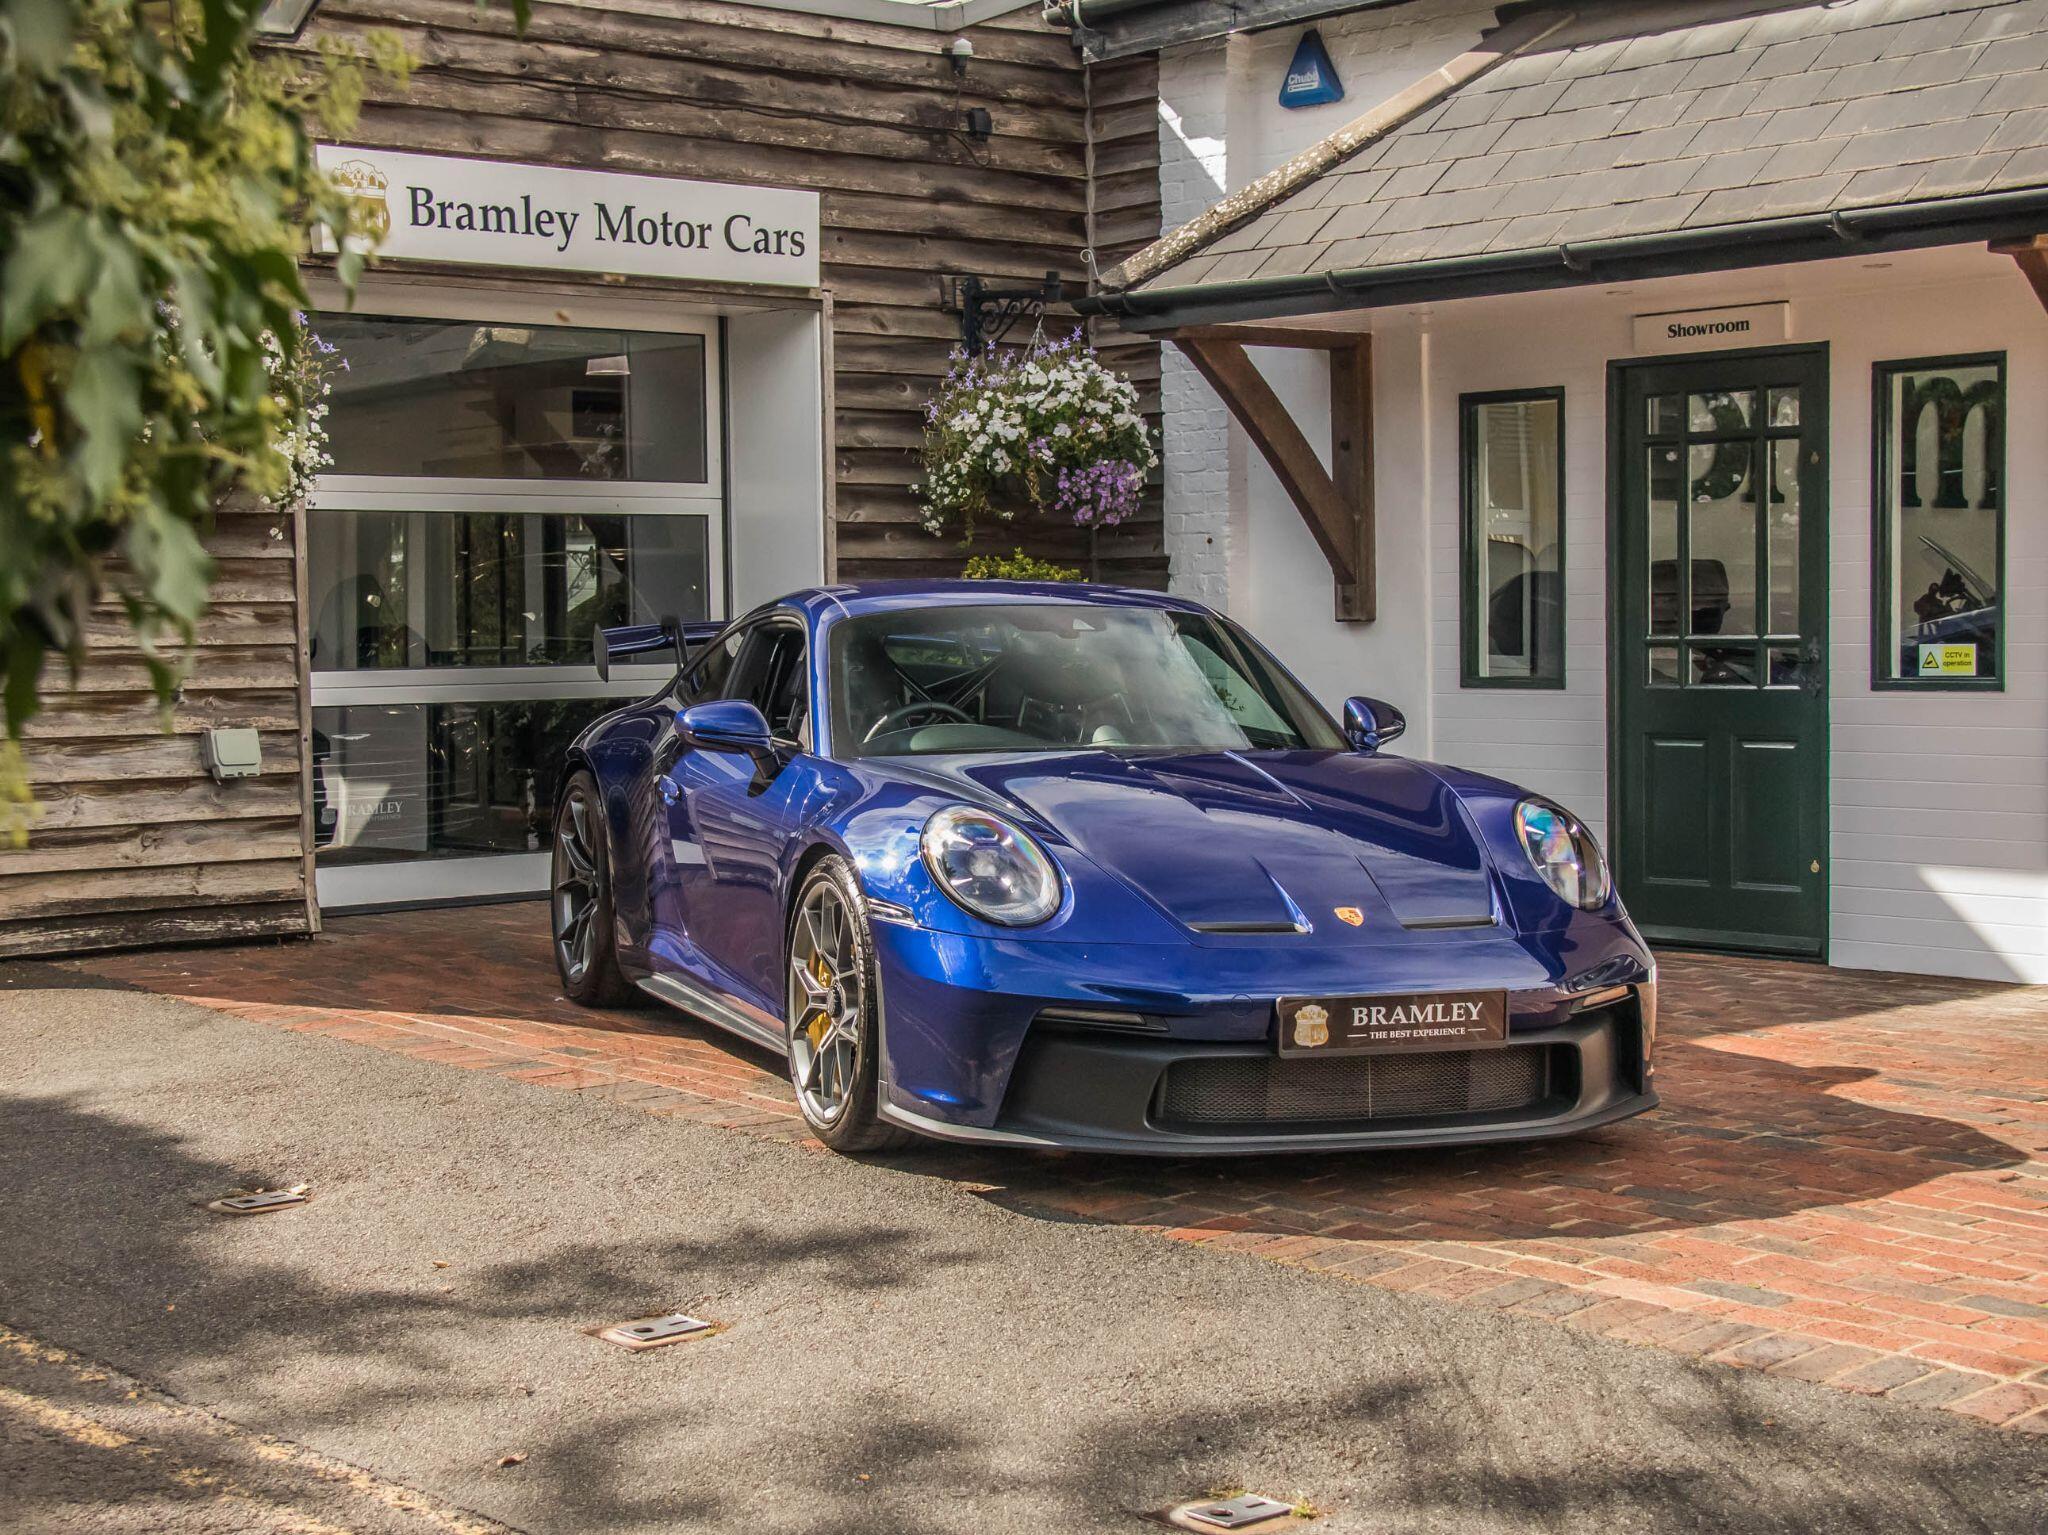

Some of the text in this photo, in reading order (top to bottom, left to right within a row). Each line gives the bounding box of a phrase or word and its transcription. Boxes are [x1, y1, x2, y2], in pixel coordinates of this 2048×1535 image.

[406, 185, 806, 258] Bramley Motor Cars
[1667, 319, 1750, 339] Showroom
[1944, 651, 1970, 659] CCTV in
[1942, 660, 1972, 668] operation
[346, 801, 403, 816] RAMLEY
[1352, 1001, 1483, 1026] BRAMLEY
[1369, 1027, 1466, 1040] THE BEST EXPERIENCE
